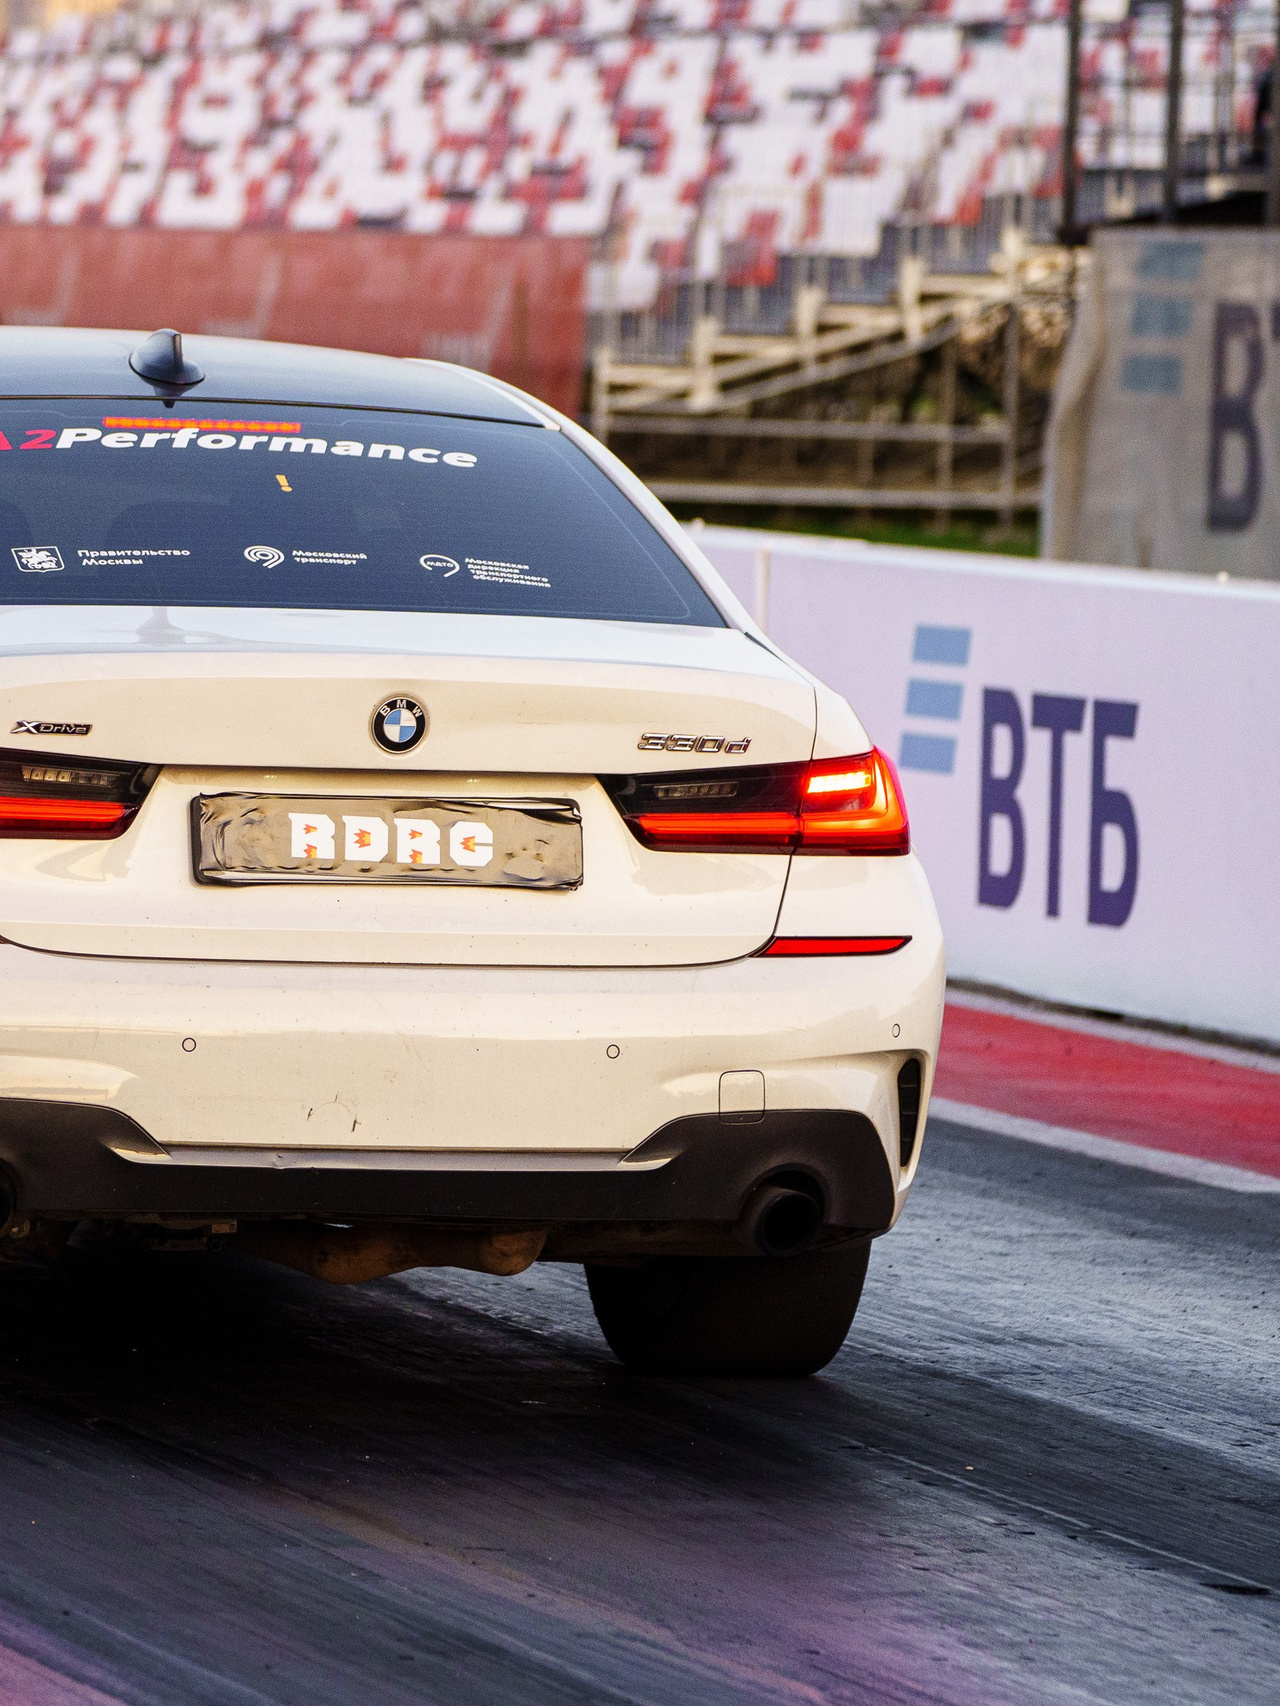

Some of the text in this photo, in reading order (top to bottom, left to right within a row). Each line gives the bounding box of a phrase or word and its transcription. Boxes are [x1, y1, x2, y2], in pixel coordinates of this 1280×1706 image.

[77, 549, 191, 558] Правительство
[292, 550, 367, 560] Московский
[82, 558, 143, 566] Москвы
[294, 557, 357, 565] транспорт
[465, 557, 530, 570] Московская
[380, 699, 423, 717] BMW
[637, 732, 752, 754] 330d
[977, 686, 1140, 928] ВТБ
[288, 812, 494, 867] RDRC
